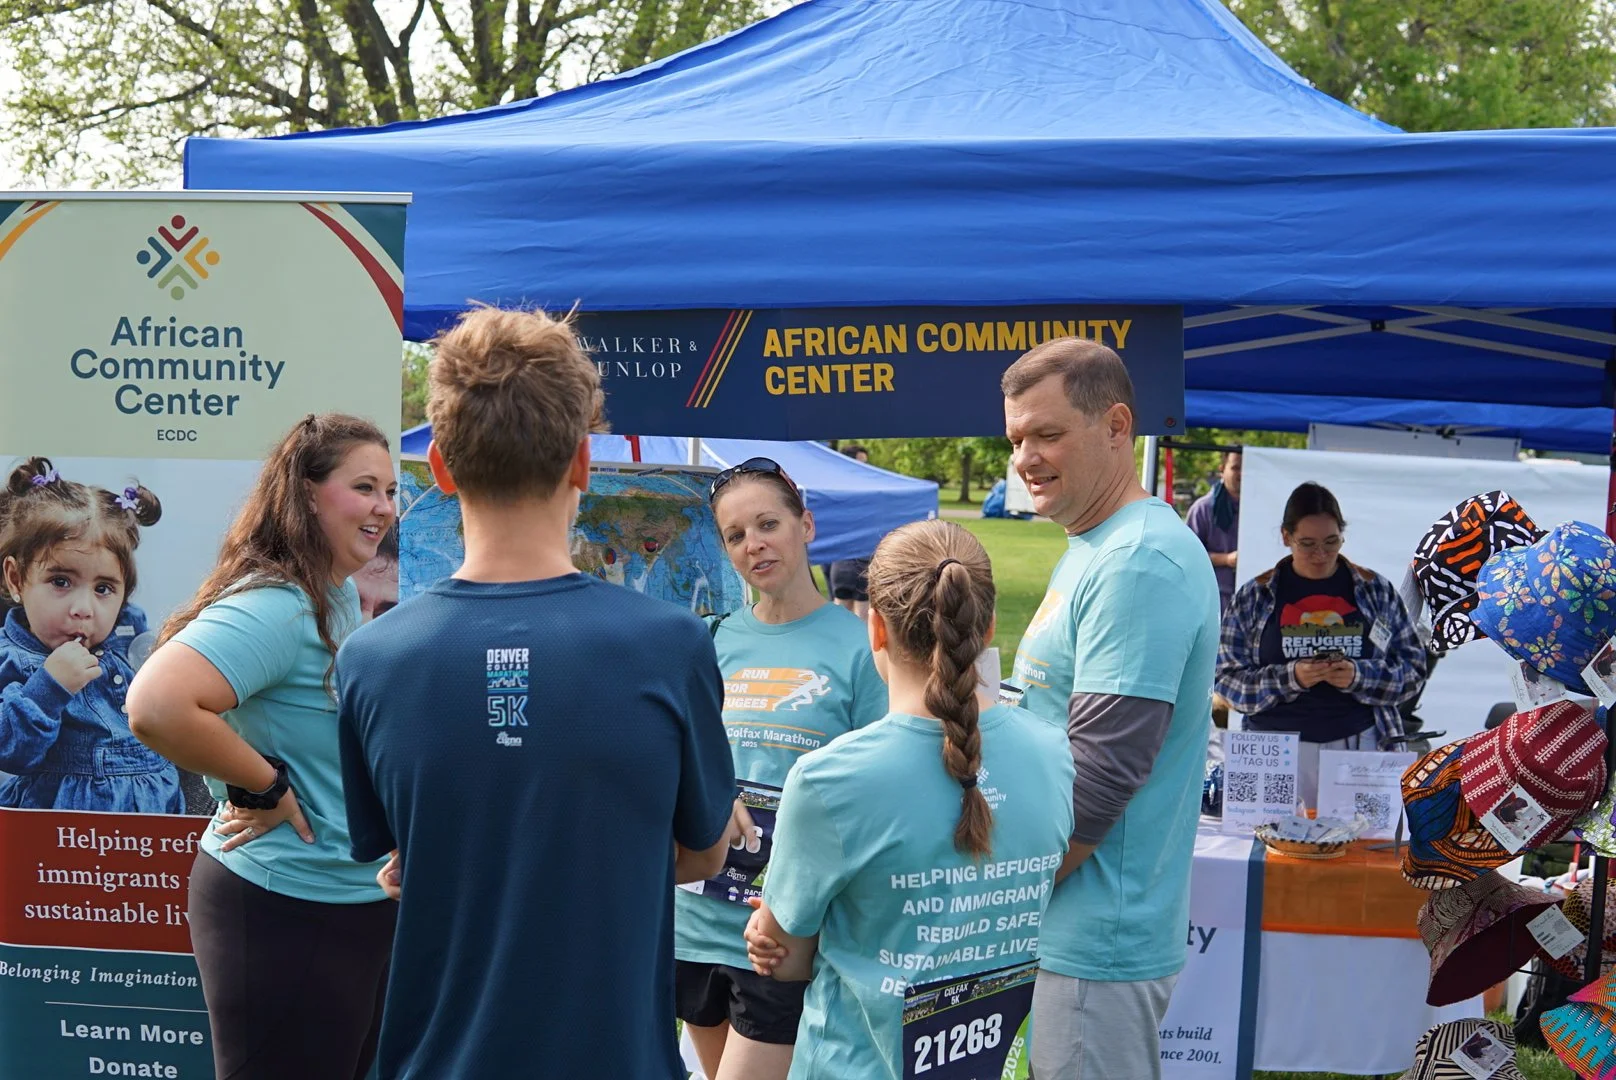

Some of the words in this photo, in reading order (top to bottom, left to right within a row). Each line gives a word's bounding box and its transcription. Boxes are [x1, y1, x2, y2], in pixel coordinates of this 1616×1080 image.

[110, 316, 243, 348] African
[763, 324, 907, 357] AFRICAN
[916, 319, 1132, 353] COMMUNITY
[576, 336, 682, 354] WALKER
[689, 340, 697, 351] &
[70, 348, 285, 389] Community
[597, 361, 681, 378] UNLOP
[765, 363, 895, 395] CENTER
[115, 384, 239, 416] Center
[157, 429, 198, 442] ECDC
[1282, 636, 1362, 647] REFUGEES
[487, 648, 529, 664] DENVER
[487, 663, 528, 671] COLFAX
[487, 670, 528, 678] MARATHON
[742, 669, 770, 679] RUN
[724, 683, 748, 693] FOR
[487, 695, 528, 727] 5K
[727, 728, 760, 739] Colfax
[763, 730, 821, 748] Marathon
[1231, 733, 1266, 742] FOLLOW
[1268, 735, 1279, 743] US
[1231, 743, 1257, 756] LIKE
[1262, 745, 1280, 756] US
[1242, 757, 1263, 766] TAG
[1266, 758, 1279, 767] US
[56, 826, 153, 857] Helping
[37, 863, 180, 892] immigrants
[891, 865, 977, 889] HELPING
[24, 901, 159, 924] sustainable
[902, 897, 944, 916] AND
[917, 918, 990, 943] REBUILD
[879, 944, 997, 971] SUSTAINABLE
[0, 961, 81, 984] Belonging
[90, 967, 198, 987] Imagination
[944, 983, 969, 998] COLFAX
[951, 995, 960, 1005] 5K
[60, 1019, 131, 1040] Learn
[140, 1024, 204, 1045] More
[1176, 1026, 1213, 1040] build
[914, 1013, 1003, 1075] 21263
[1003, 1035, 1025, 1080] 2025
[1186, 1048, 1222, 1064] 2001.
[89, 1057, 178, 1079] Donate
